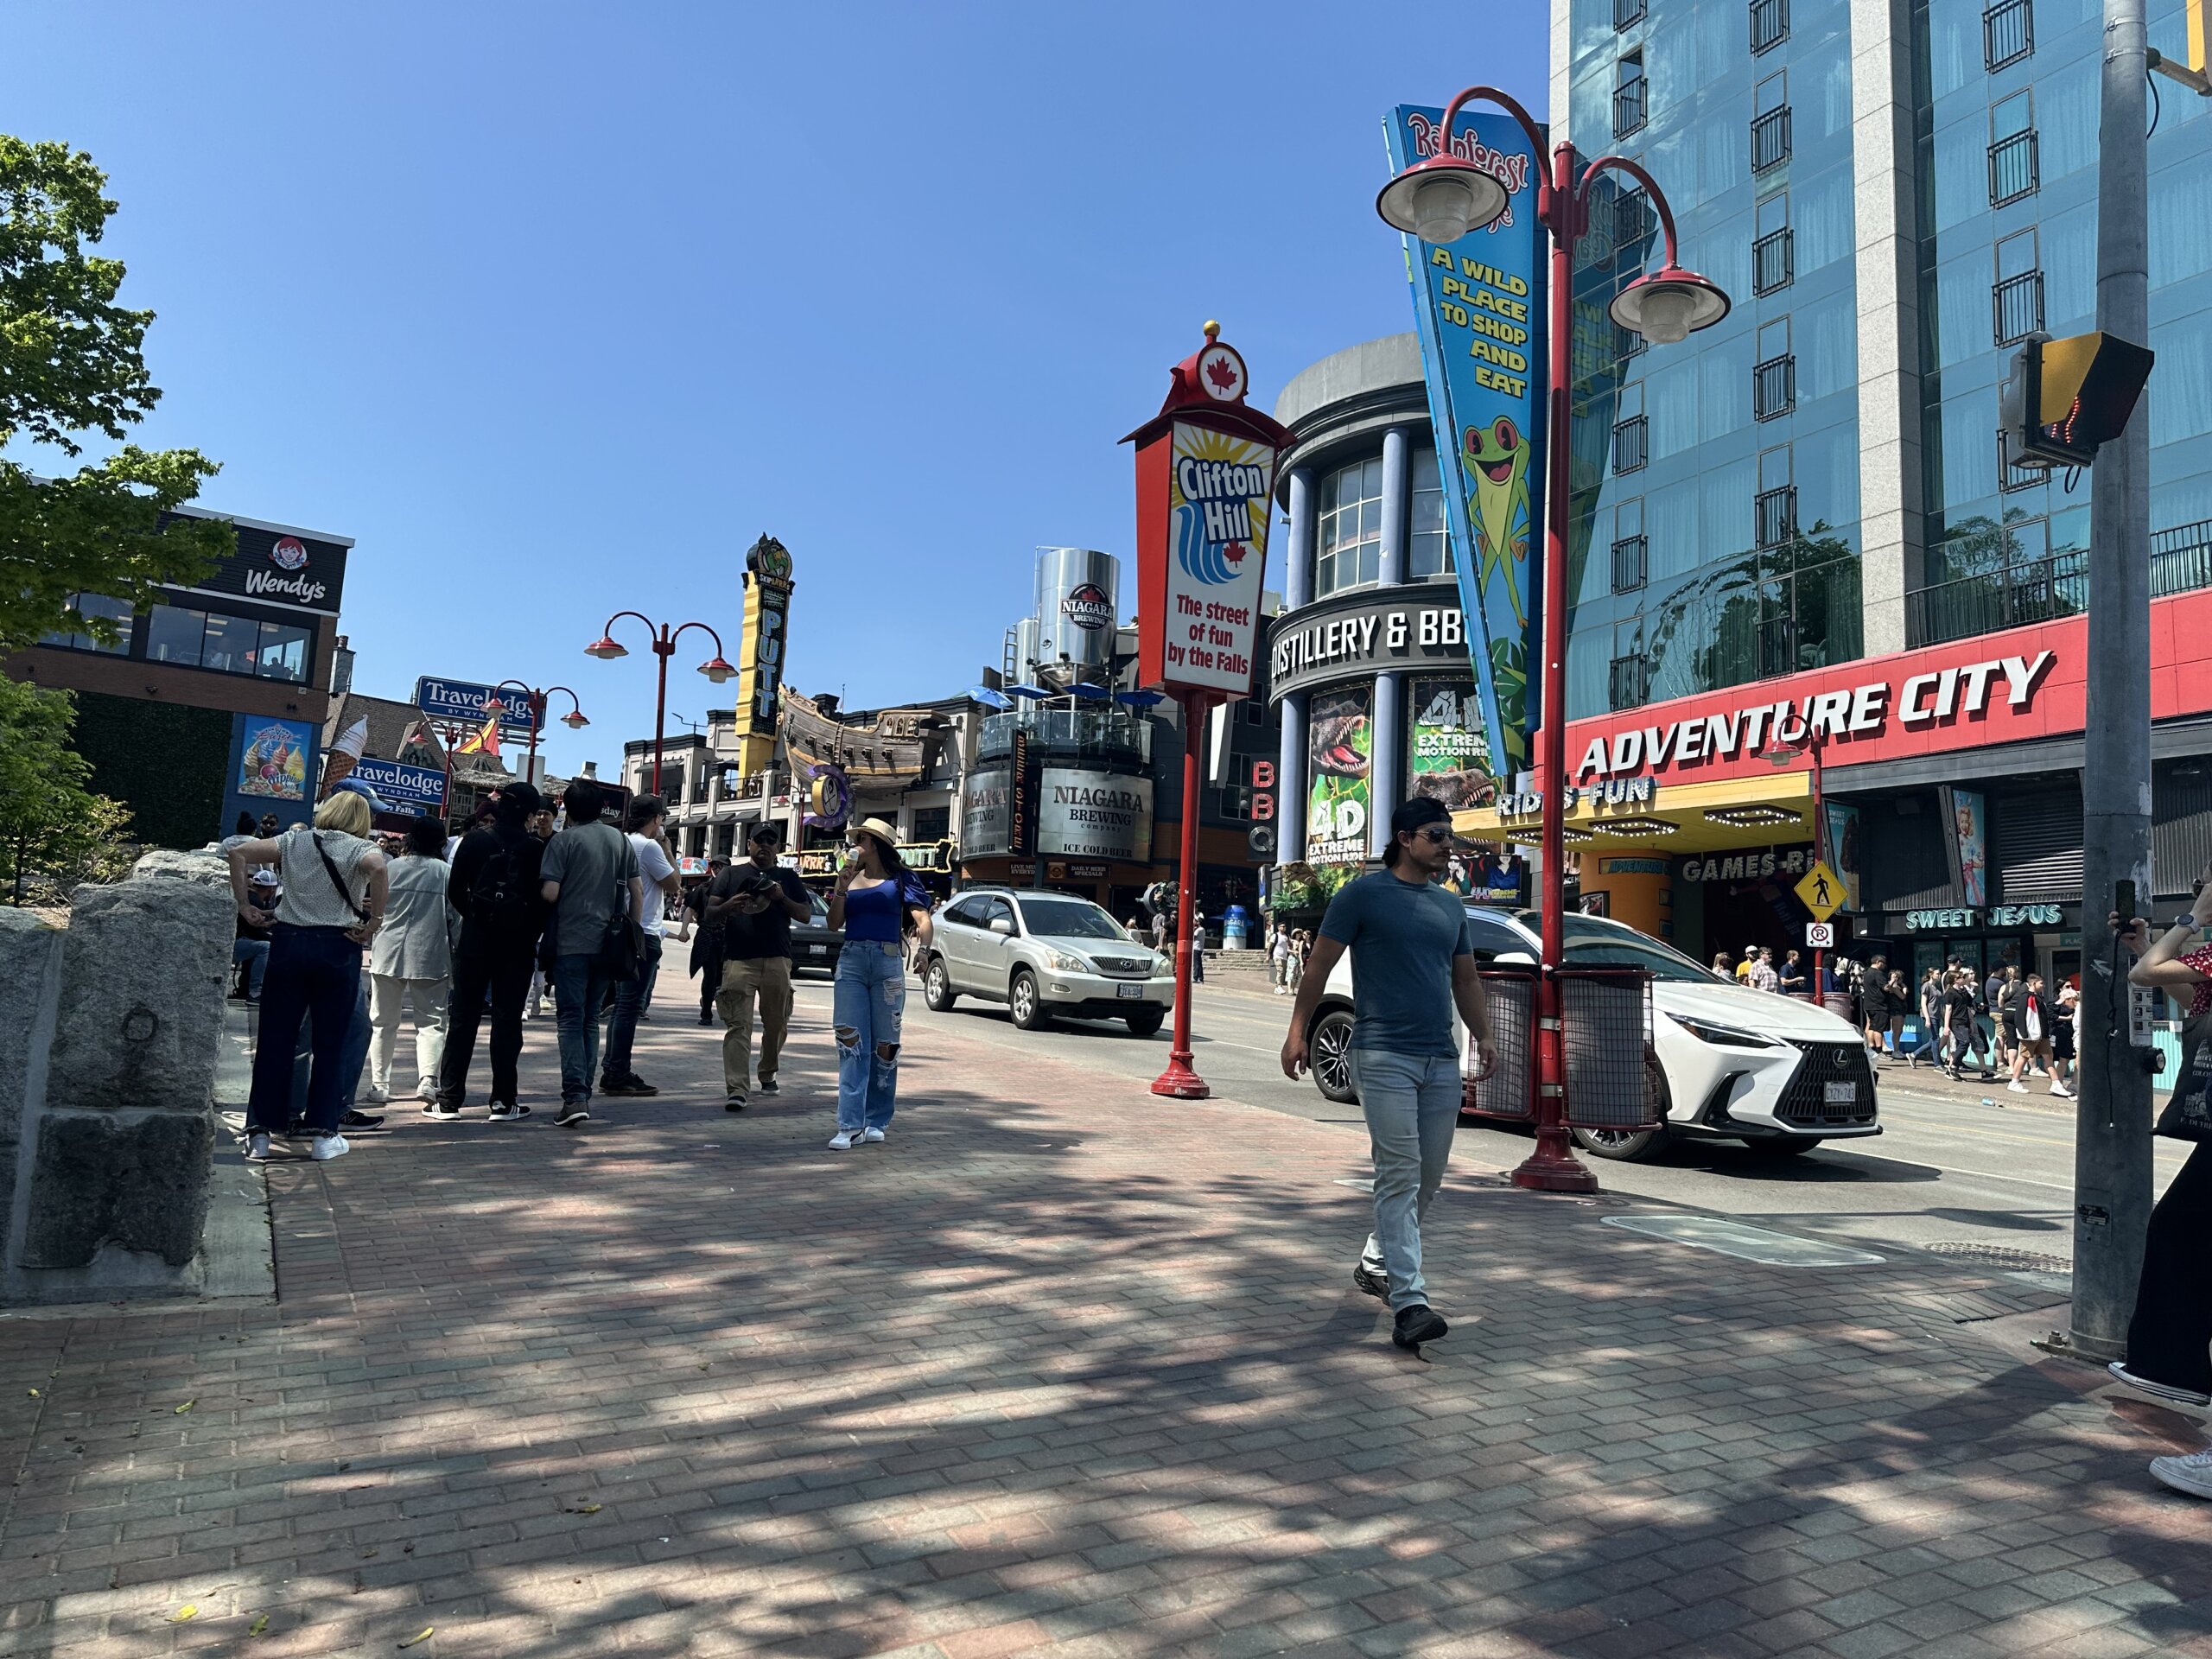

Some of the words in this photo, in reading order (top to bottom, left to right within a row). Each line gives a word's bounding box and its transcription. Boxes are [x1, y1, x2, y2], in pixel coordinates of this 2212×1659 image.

[1431, 247, 1454, 270] A
[1460, 257, 1529, 297] WILD
[1442, 276, 1528, 324] PLACE
[1440, 301, 1469, 327] TO
[1472, 313, 1528, 346] SHOP
[1470, 339, 1528, 373] AND
[1475, 365, 1527, 398] EAT
[1179, 459, 1262, 500] Clifton
[1204, 501, 1250, 541] Hill
[245, 569, 326, 603] Wendy's
[1062, 601, 1113, 619] NIAGARA
[1073, 614, 1106, 626] BREWING
[1177, 594, 1202, 617] The
[1206, 601, 1249, 626] street
[1189, 623, 1205, 642] of
[1209, 625, 1233, 647] fun
[1271, 614, 1377, 679] DISTILLERY
[1387, 612, 1407, 647] &
[1419, 609, 1469, 645] BB
[755, 608, 782, 718] PUTT
[1168, 641, 1185, 667] by
[1189, 646, 1213, 669] the
[1217, 652, 1249, 675] Falls
[1575, 682, 1887, 779] ADVENTURE
[1898, 650, 2054, 722] CITY
[1418, 734, 1487, 747] EXTREM
[1418, 747, 1471, 757] MOTION
[377, 786, 421, 798] WYNDHAM
[1053, 785, 1144, 813] NIAGARA
[1589, 775, 1656, 806] FUN
[395, 804, 416, 815] Falls
[1014, 787, 1024, 849] STORE
[1069, 809, 1131, 826] BREWING
[1249, 760, 1275, 853] BBQ
[1828, 809, 1845, 817] SWEET
[1081, 823, 1122, 833] company
[978, 843, 996, 853] BEER
[1064, 843, 1081, 853] ICE
[1083, 845, 1109, 855] COLD
[1109, 848, 1133, 858] BEER
[1309, 838, 1364, 855] EXTREME
[1309, 851, 1341, 865] MOTION
[777, 855, 798, 868] SKIP
[1682, 853, 1776, 882] GAMES
[1906, 909, 1974, 930] SWEET
